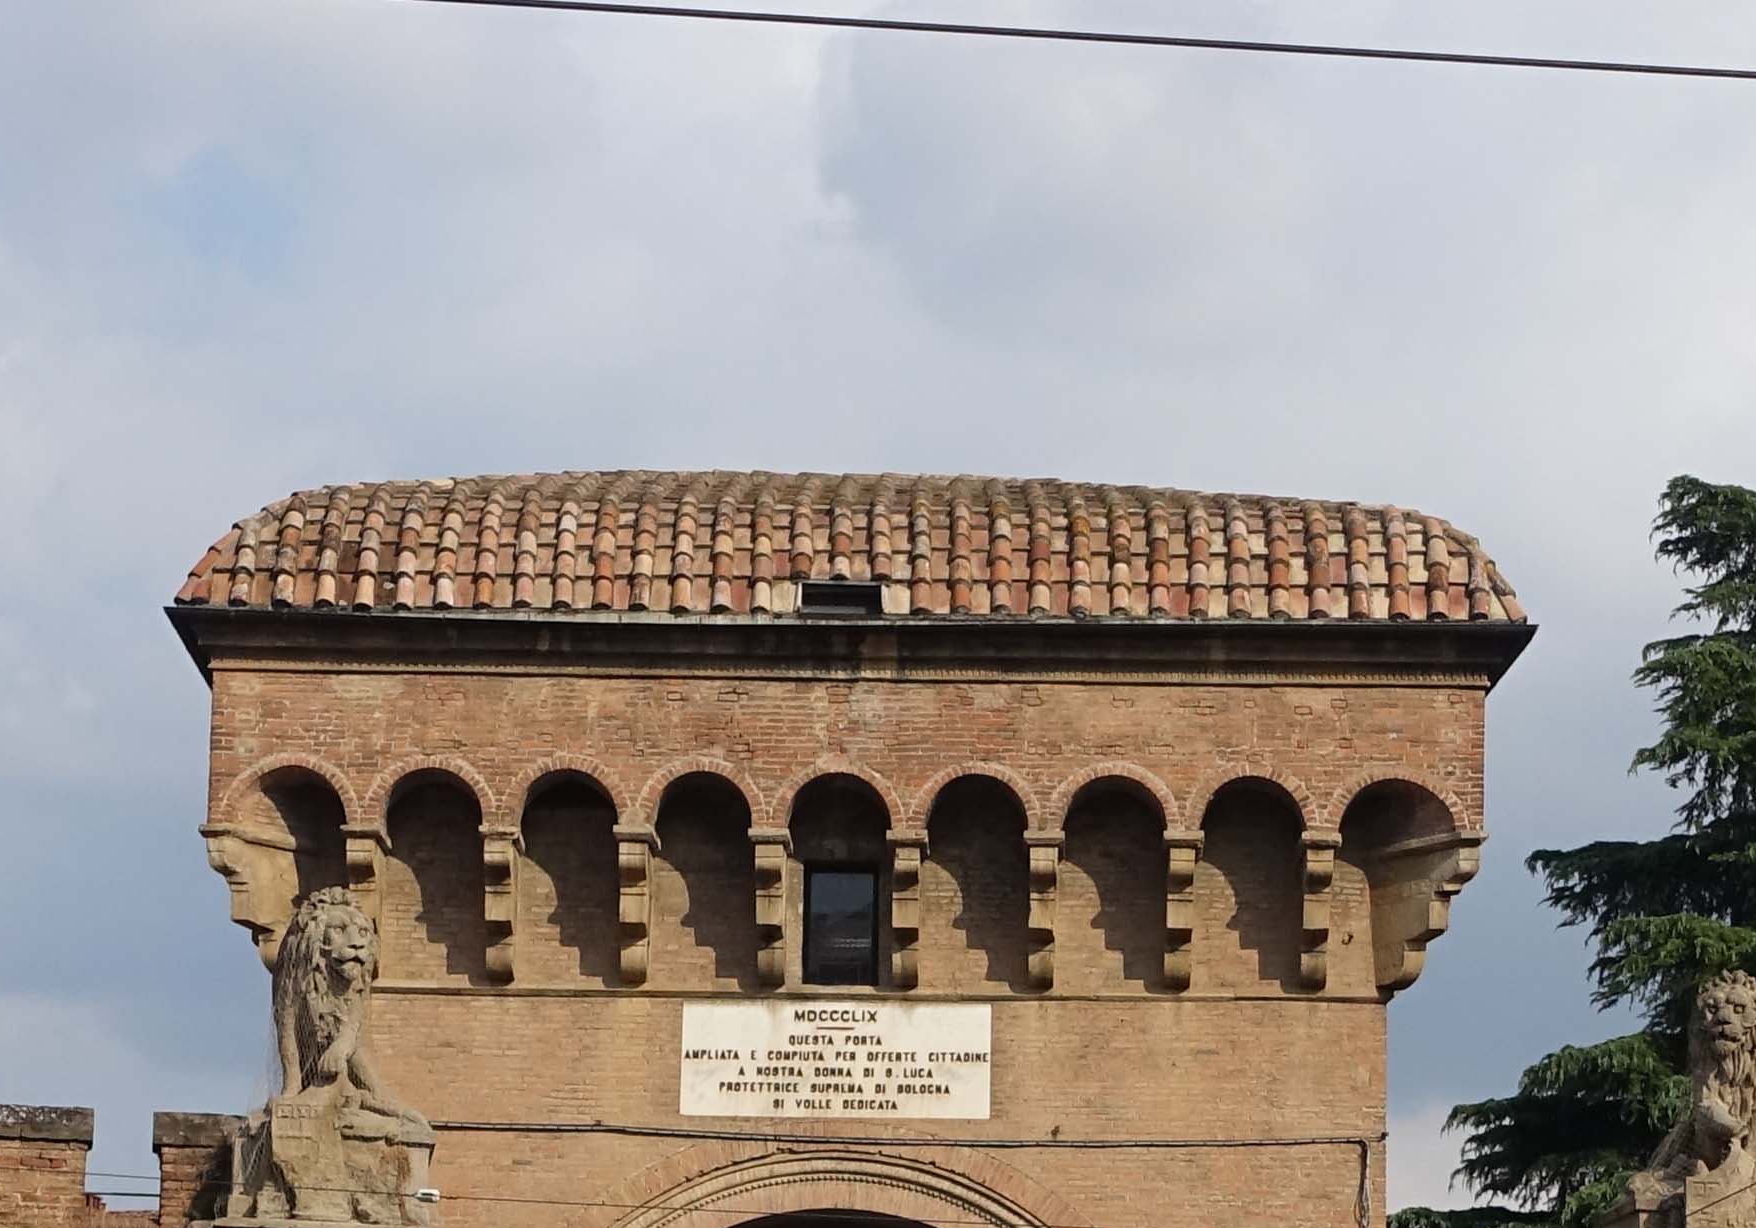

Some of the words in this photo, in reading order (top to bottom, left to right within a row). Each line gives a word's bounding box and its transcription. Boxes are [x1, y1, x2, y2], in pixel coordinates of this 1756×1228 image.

[794, 1010, 878, 1022] MDCCCLIX
[789, 1035, 834, 1046] QUESTA
[845, 1035, 882, 1046] PORTA
[684, 1050, 740, 1060] AMPLIATA
[750, 1050, 757, 1060] E
[767, 1051, 824, 1061] COMPIUTA
[835, 1051, 856, 1062] PER
[867, 1052, 917, 1062] OFFERTE
[928, 1052, 989, 1063] CITTADINE
[738, 1066, 745, 1076] A
[756, 1066, 803, 1077] NOSTRA
[814, 1067, 852, 1078] DONNA
[863, 1067, 875, 1078] DI
[719, 1082, 799, 1093] PROTETTRICE
[810, 1083, 863, 1094] SUPREMA
[875, 1083, 885, 1094] DI
[897, 1084, 950, 1094] BOLOGNA
[773, 1099, 784, 1109] SI
[795, 1099, 832, 1110] VOLLE
[843, 1100, 898, 1110] DEDICATA
